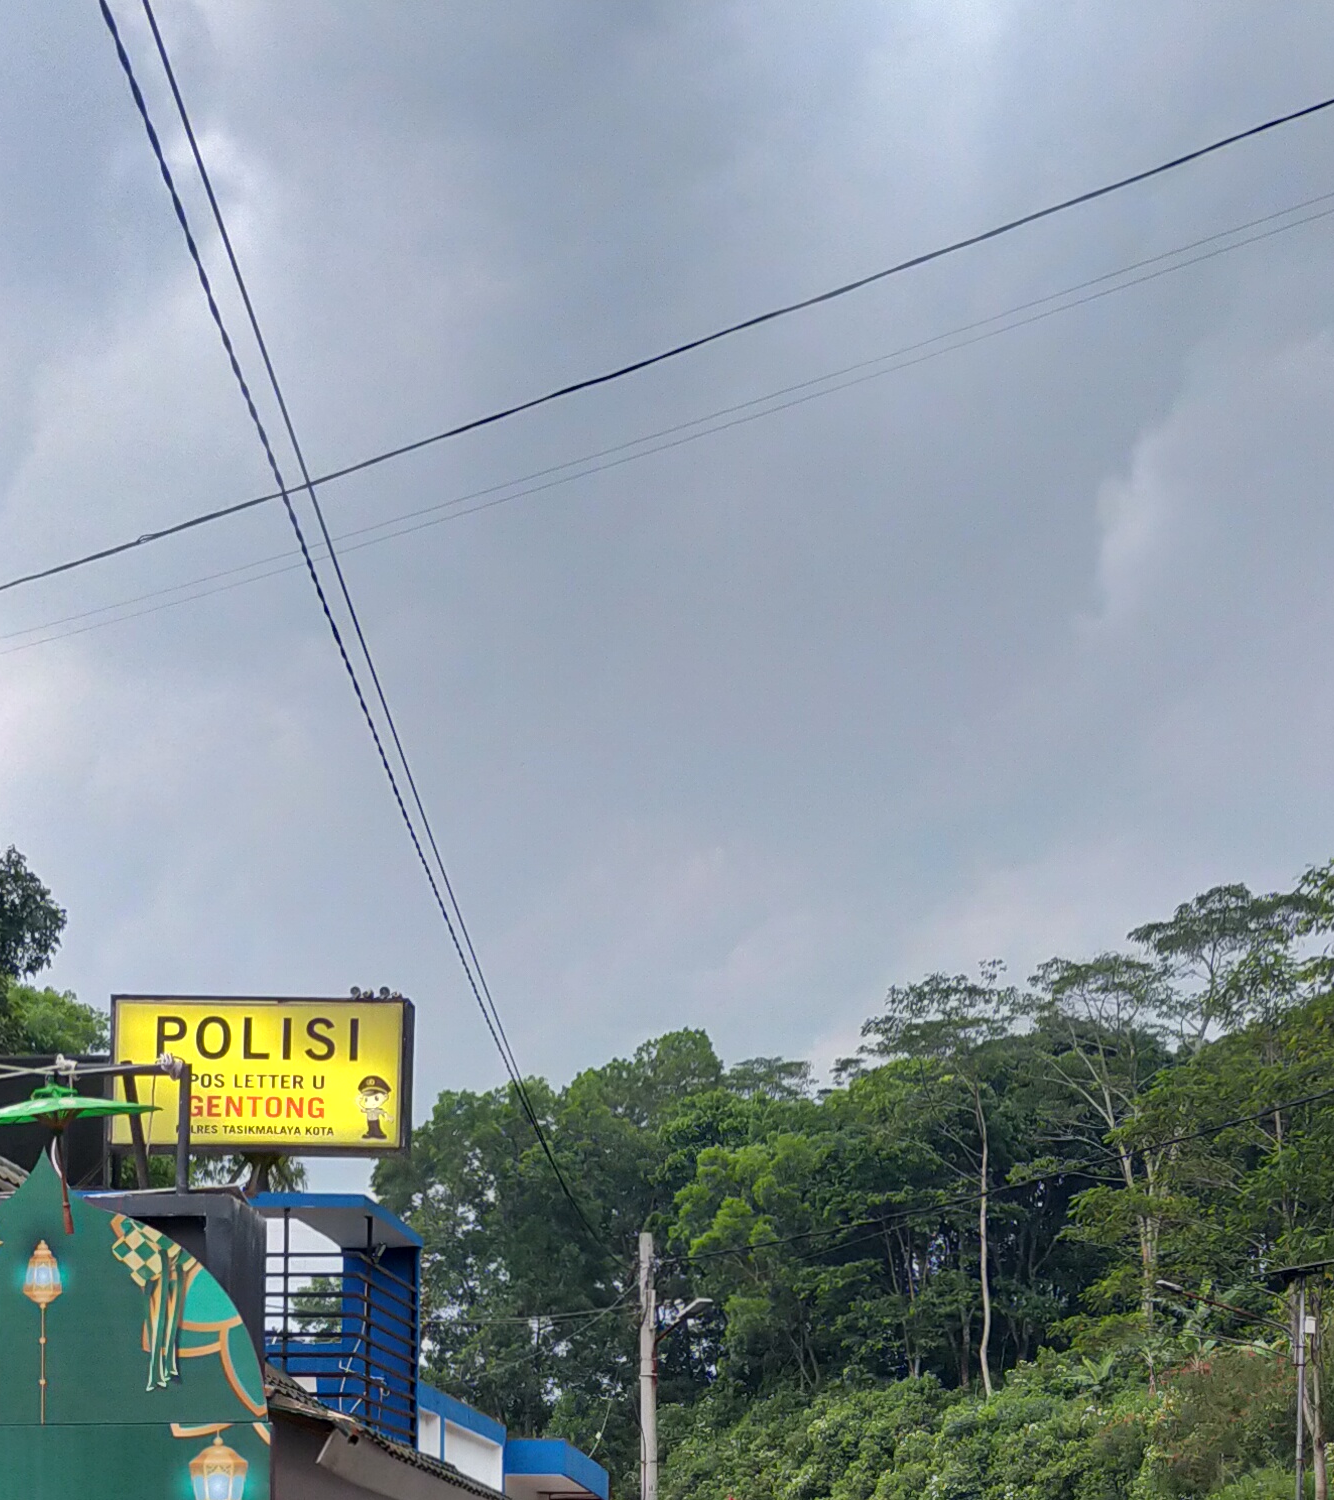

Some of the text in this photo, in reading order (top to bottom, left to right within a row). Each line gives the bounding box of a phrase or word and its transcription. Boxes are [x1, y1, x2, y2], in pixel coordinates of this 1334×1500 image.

[157, 1015, 360, 1062] POLISI
[190, 1073, 325, 1090] POS LETTER U
[189, 1095, 325, 1119] GENTONG
[175, 1124, 334, 1136] LRES TASIKMALAYA KOTA
